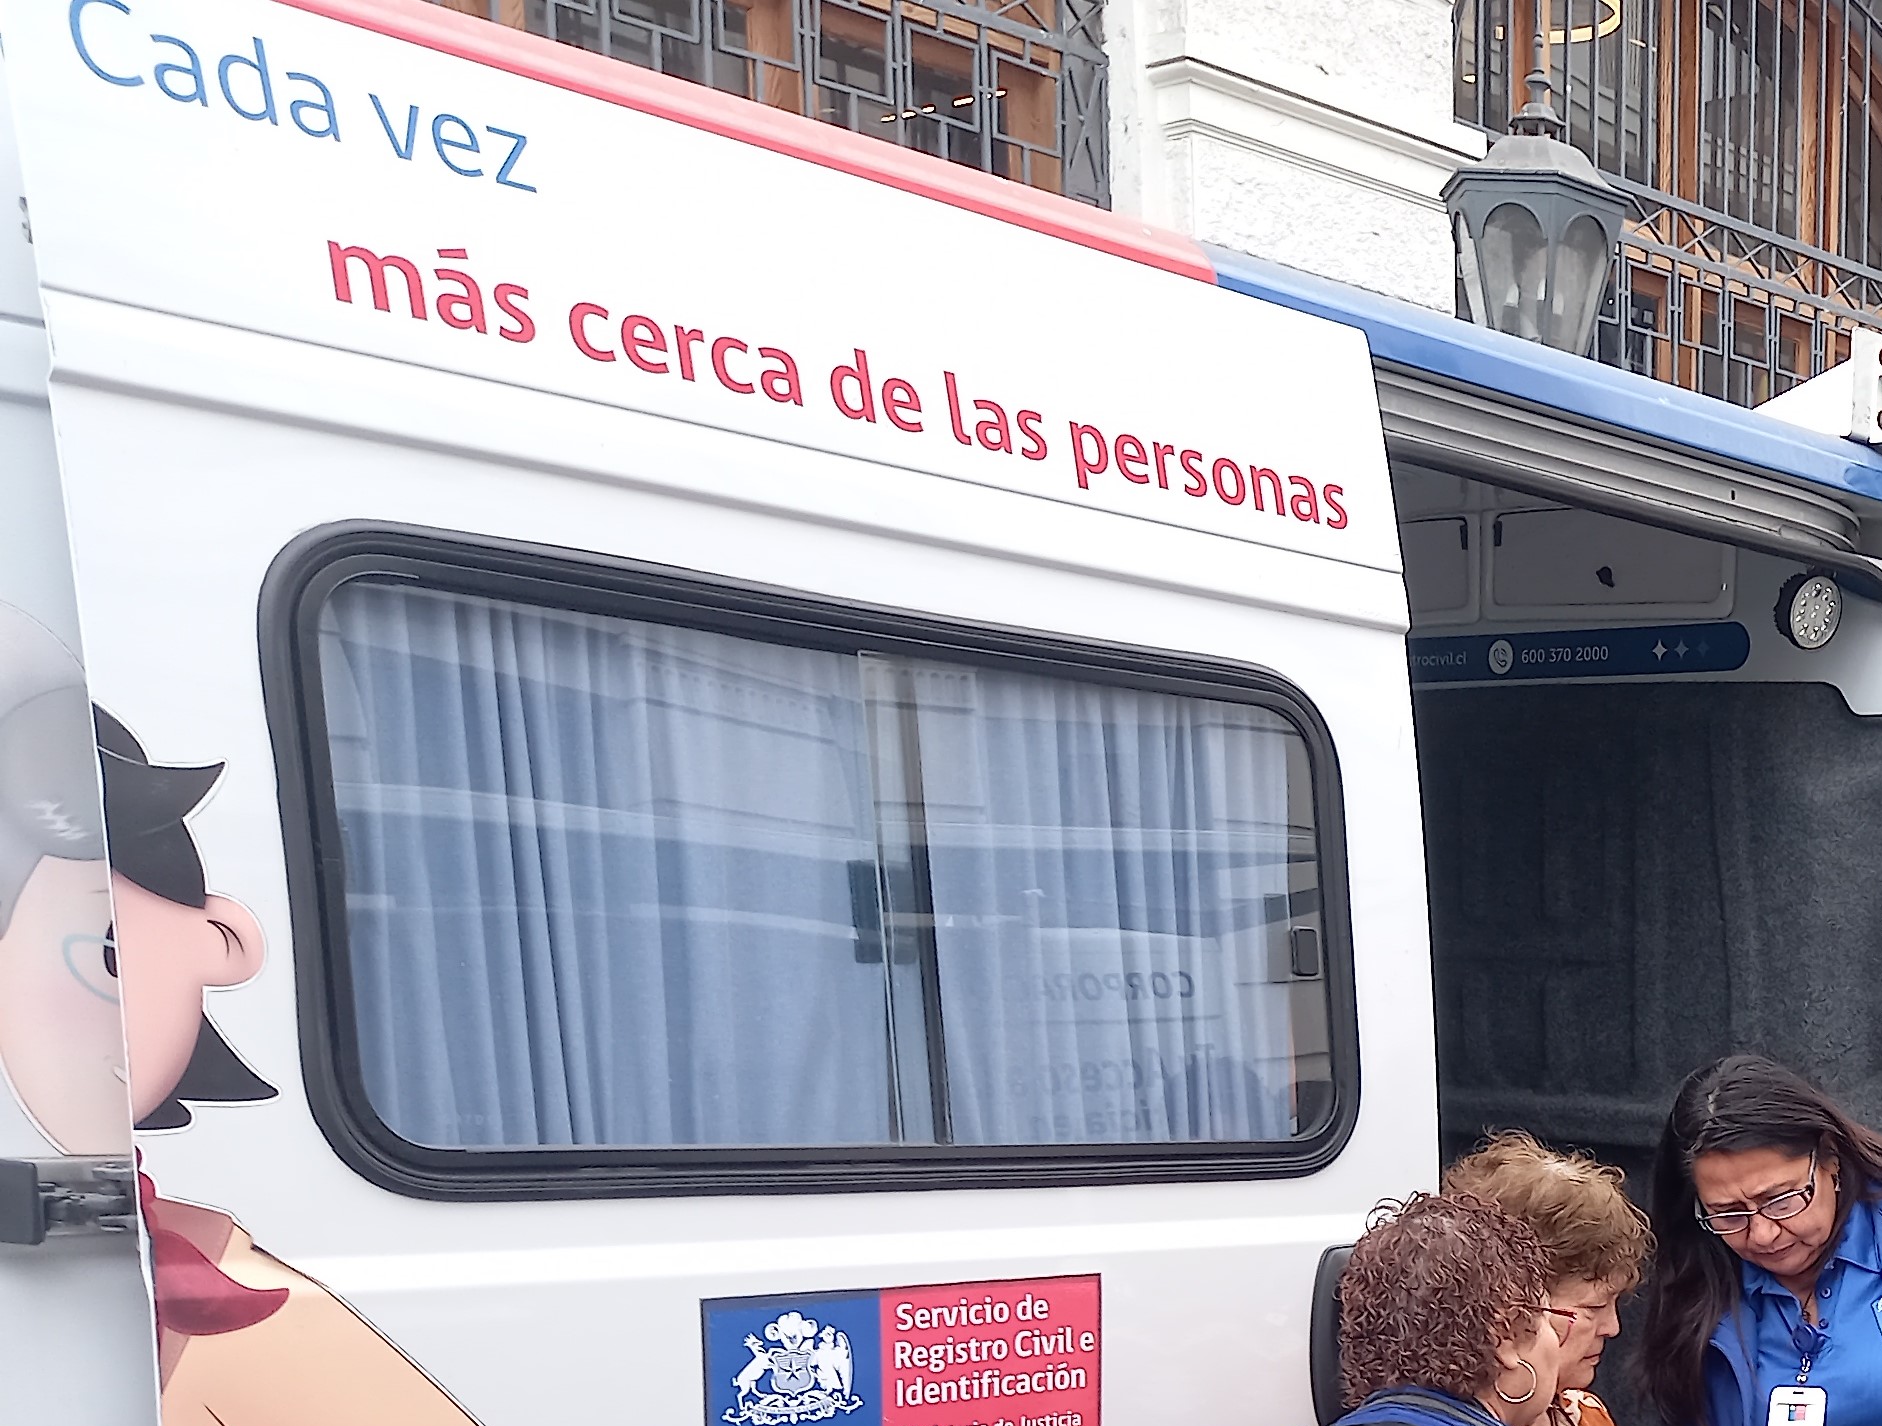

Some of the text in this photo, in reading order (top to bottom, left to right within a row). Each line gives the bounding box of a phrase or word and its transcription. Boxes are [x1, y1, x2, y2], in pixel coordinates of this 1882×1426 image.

[68, 0, 538, 193] Cada vez
[327, 239, 1350, 531] más cerca de las personas
[1521, 645, 1609, 664] 600 370 2000
[895, 1295, 1050, 1333] Servicio de
[893, 1326, 1095, 1373] Registro Civil e
[895, 1363, 1087, 1409] Identificación
